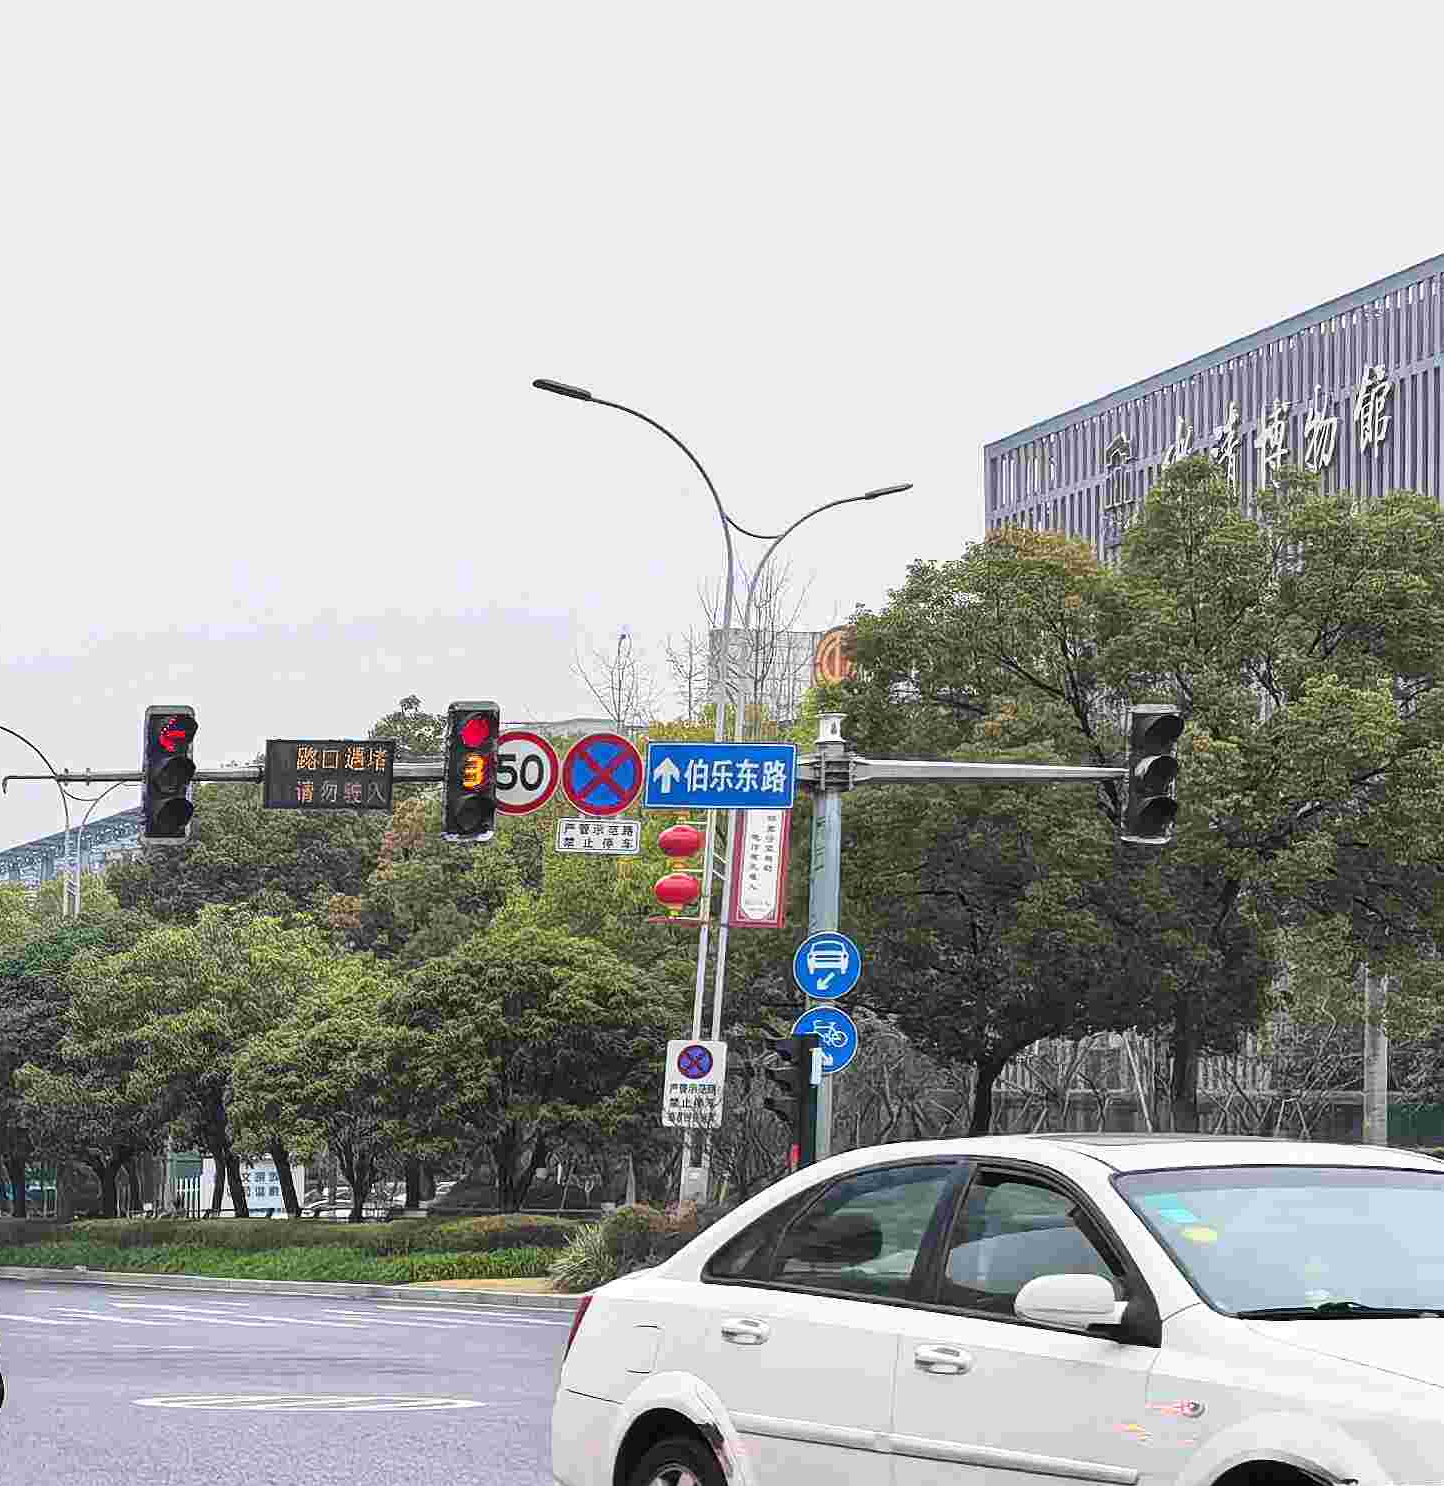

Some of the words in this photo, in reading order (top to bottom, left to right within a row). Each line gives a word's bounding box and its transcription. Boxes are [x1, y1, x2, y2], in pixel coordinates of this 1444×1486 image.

[496, 755, 543, 791] 50
[684, 758, 787, 793] 伯乐东路
[564, 837, 634, 849] 禁止停车
